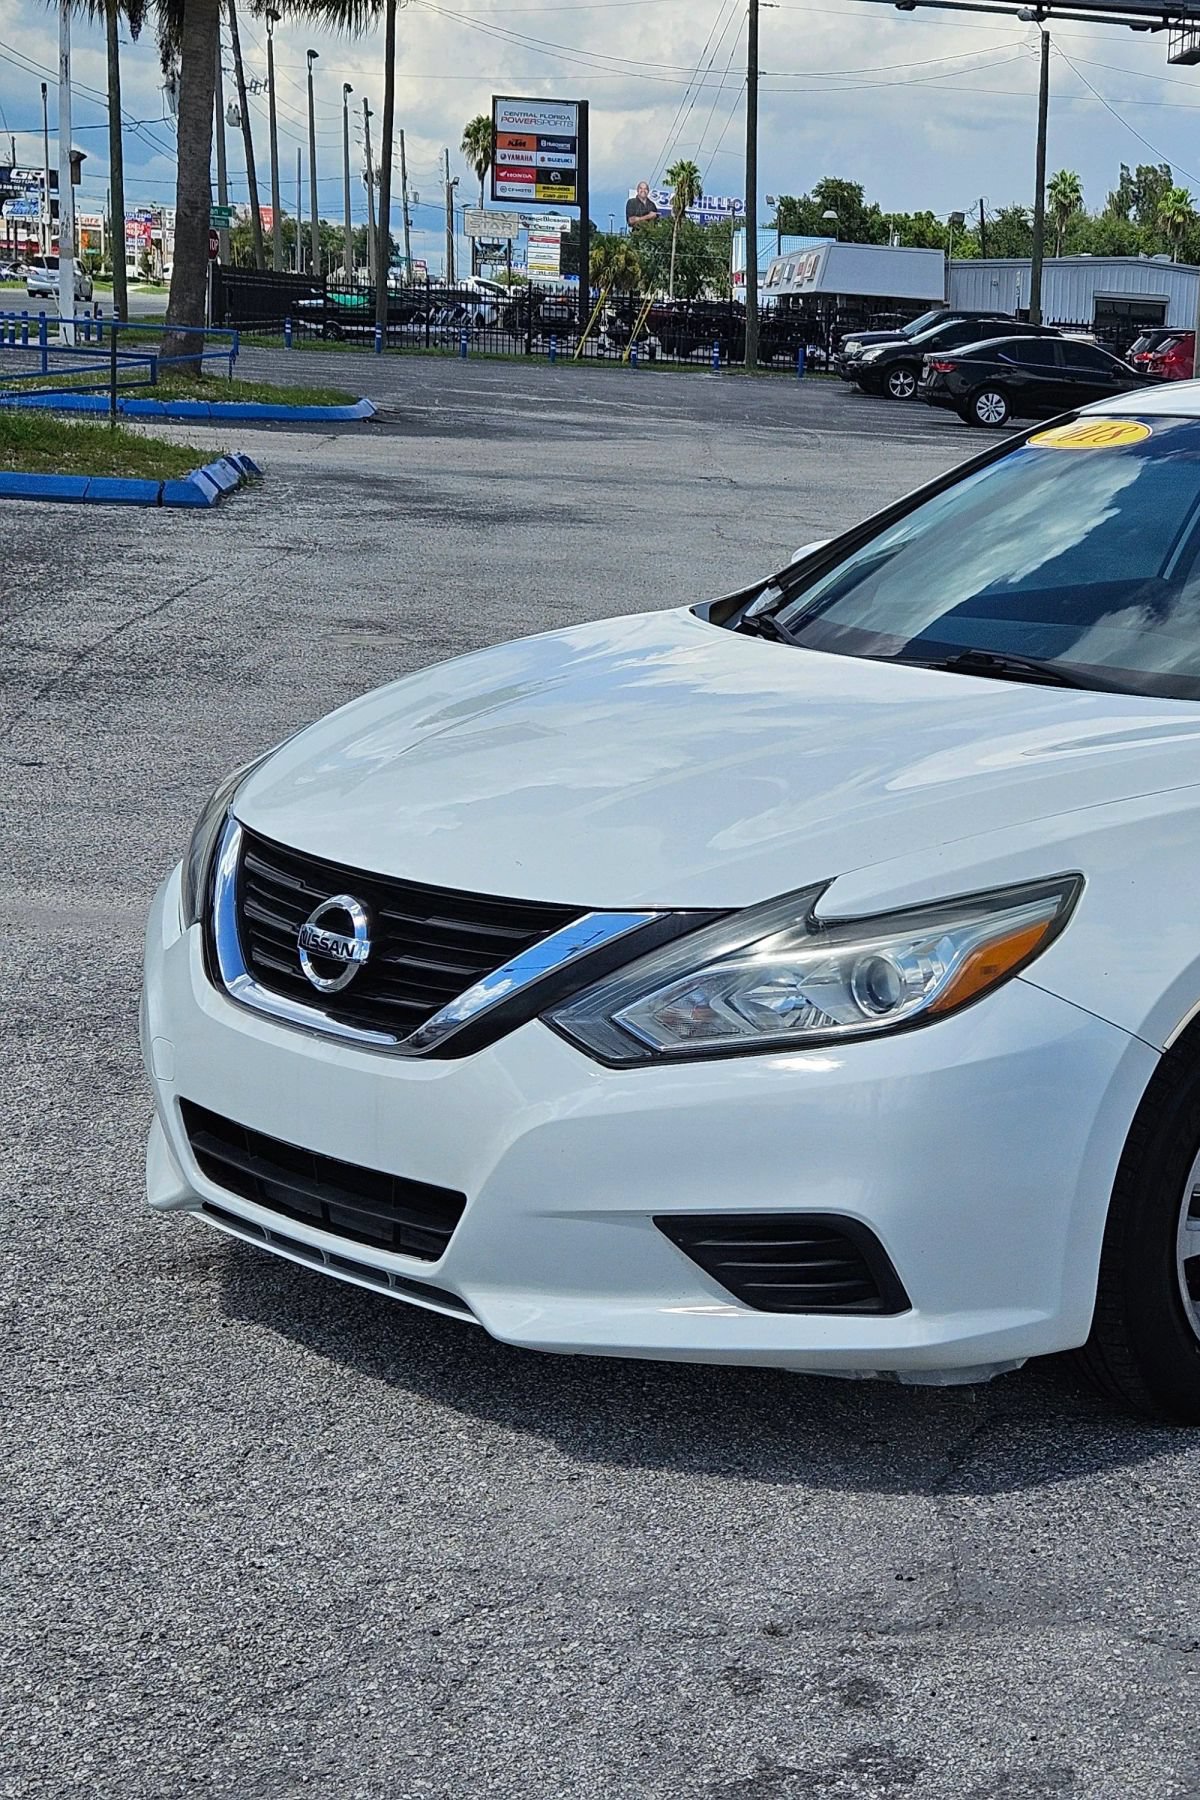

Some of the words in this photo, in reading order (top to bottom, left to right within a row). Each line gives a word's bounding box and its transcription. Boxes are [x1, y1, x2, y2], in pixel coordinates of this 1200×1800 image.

[503, 110, 537, 119] CENTRAL
[539, 113, 571, 121] FLORIDA
[500, 116, 574, 128] POWERSPORTS
[508, 152, 533, 162] YAMAHA
[690, 194, 746, 212] MILLIO
[469, 220, 513, 231] STAR
[209, 238, 219, 251] TOP
[1038, 425, 1139, 443] 2018
[300, 926, 356, 958] NISSAN
